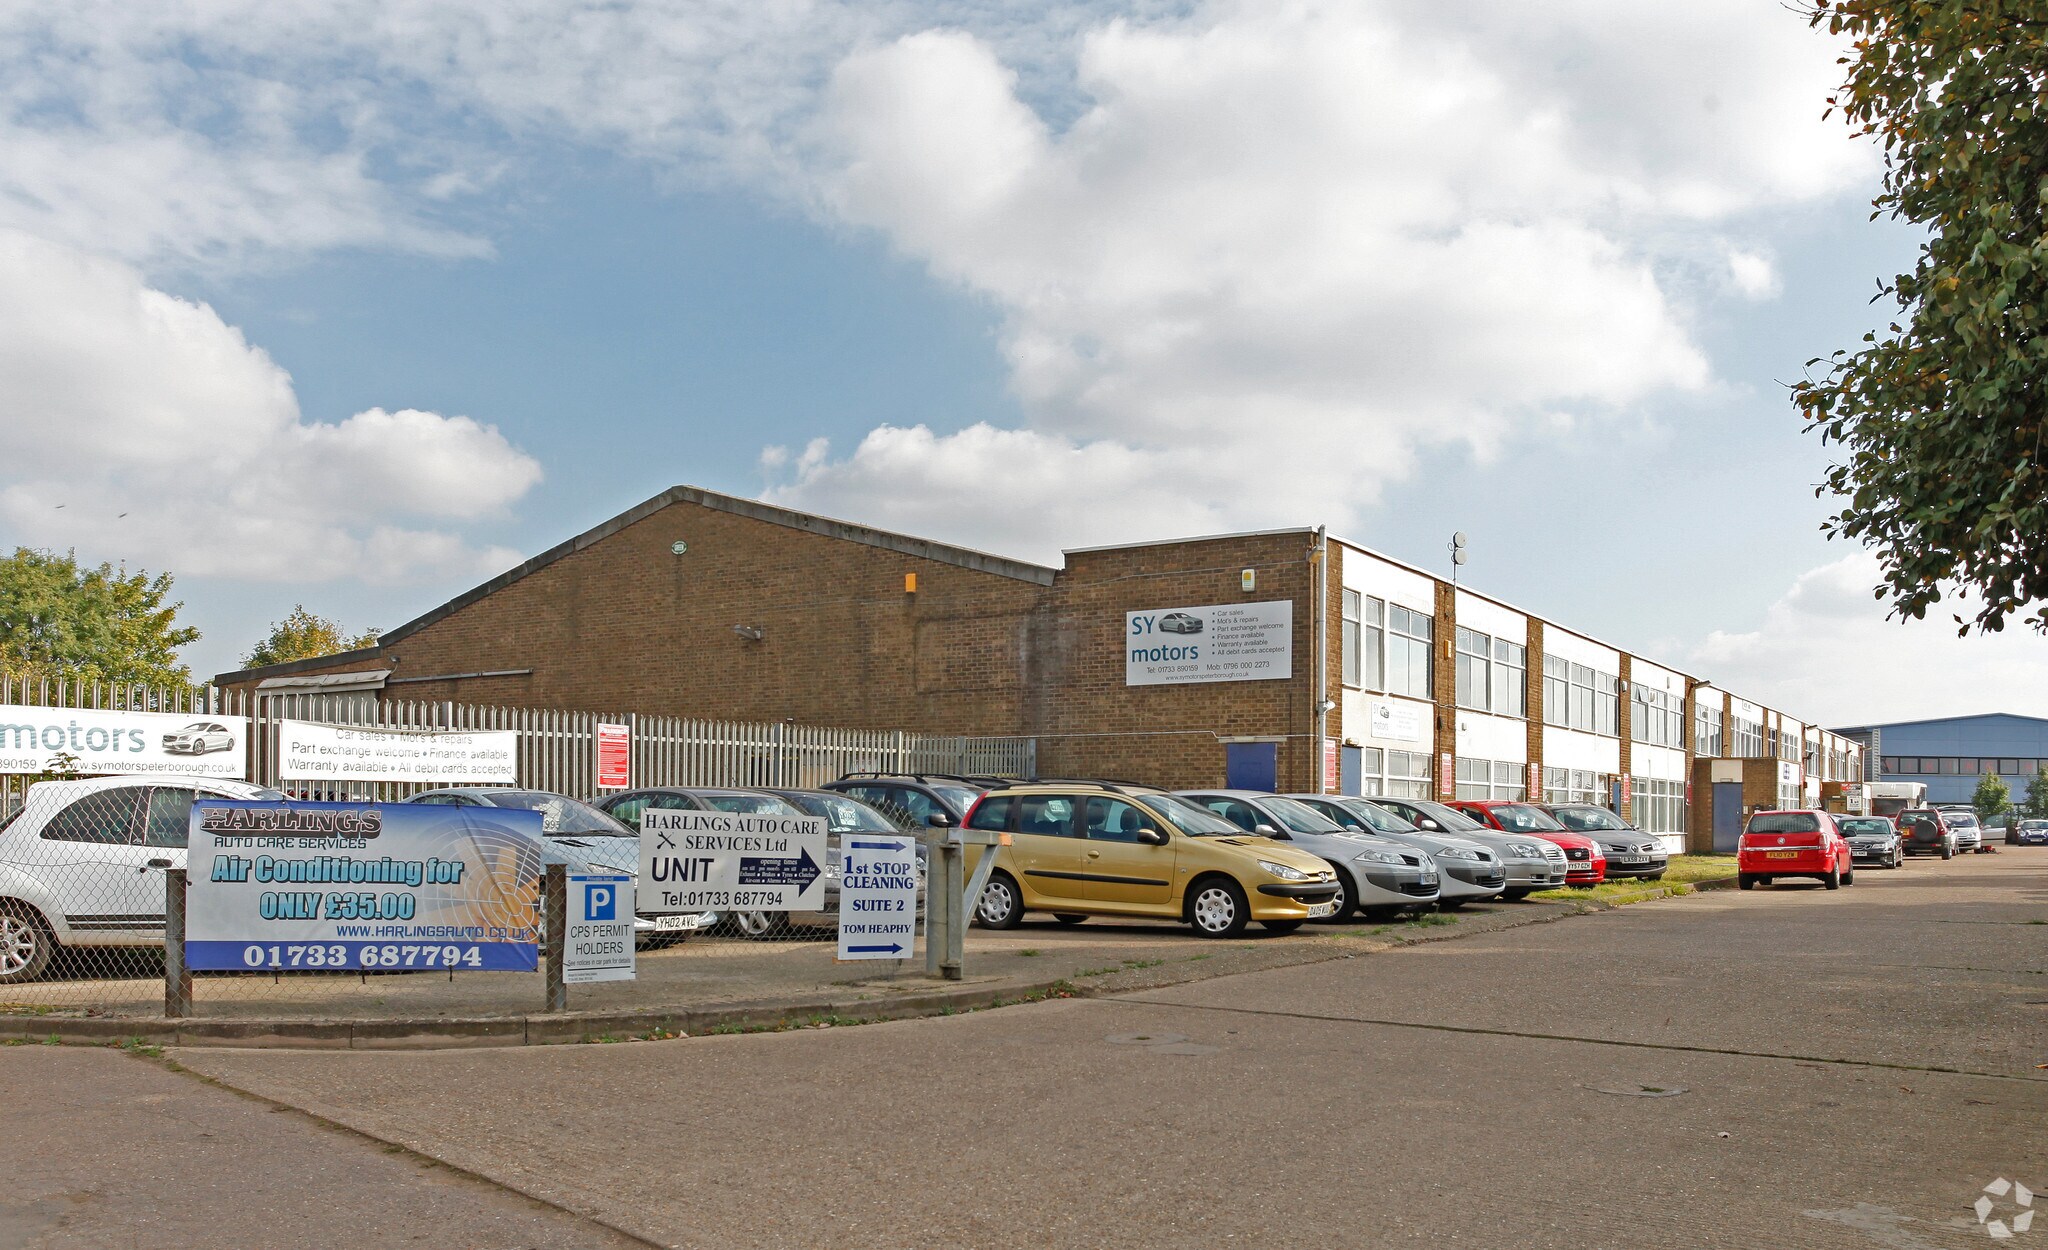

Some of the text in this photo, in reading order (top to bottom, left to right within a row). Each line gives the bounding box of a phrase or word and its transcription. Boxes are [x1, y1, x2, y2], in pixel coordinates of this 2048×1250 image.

[1132, 616, 1155, 635] SY
[1132, 645, 1199, 663] motors
[1258, 646, 1285, 654] accepted
[1255, 661, 1270, 669] 2273
[0, 720, 146, 752] motors
[336, 728, 354, 741] Car
[359, 731, 386, 742] sales
[429, 733, 437, 743] &
[441, 735, 473, 746] repairs
[292, 742, 508, 760] Part exchange welcome Finance available
[287, 759, 512, 775] Warranty available All debit cards accepted
[201, 808, 382, 836] HARLINGS
[645, 814, 820, 835] HARLINGS AUTO CARE
[214, 837, 367, 850] AUTO CARE SERVICES
[686, 835, 787, 852] SERVICES Ltd
[211, 855, 465, 887] Air Conditioning for
[652, 857, 715, 882] UNIT
[844, 855, 911, 875] 1st STOP
[844, 876, 914, 889] CLEANING
[259, 891, 415, 920] ONLY £35.00
[591, 888, 610, 917] P
[662, 891, 783, 906] Tel:01733 687794
[852, 899, 905, 912] SUITE 2
[660, 915, 695, 928] YH02 AVL
[843, 924, 911, 934] TOM HEAPHY
[337, 925, 530, 939] WWW.HARLINGSAUTO.CO.UK
[570, 924, 630, 938] CPS PERMIT
[244, 945, 482, 967] 01733 687794
[575, 941, 624, 955] HOLDERS
